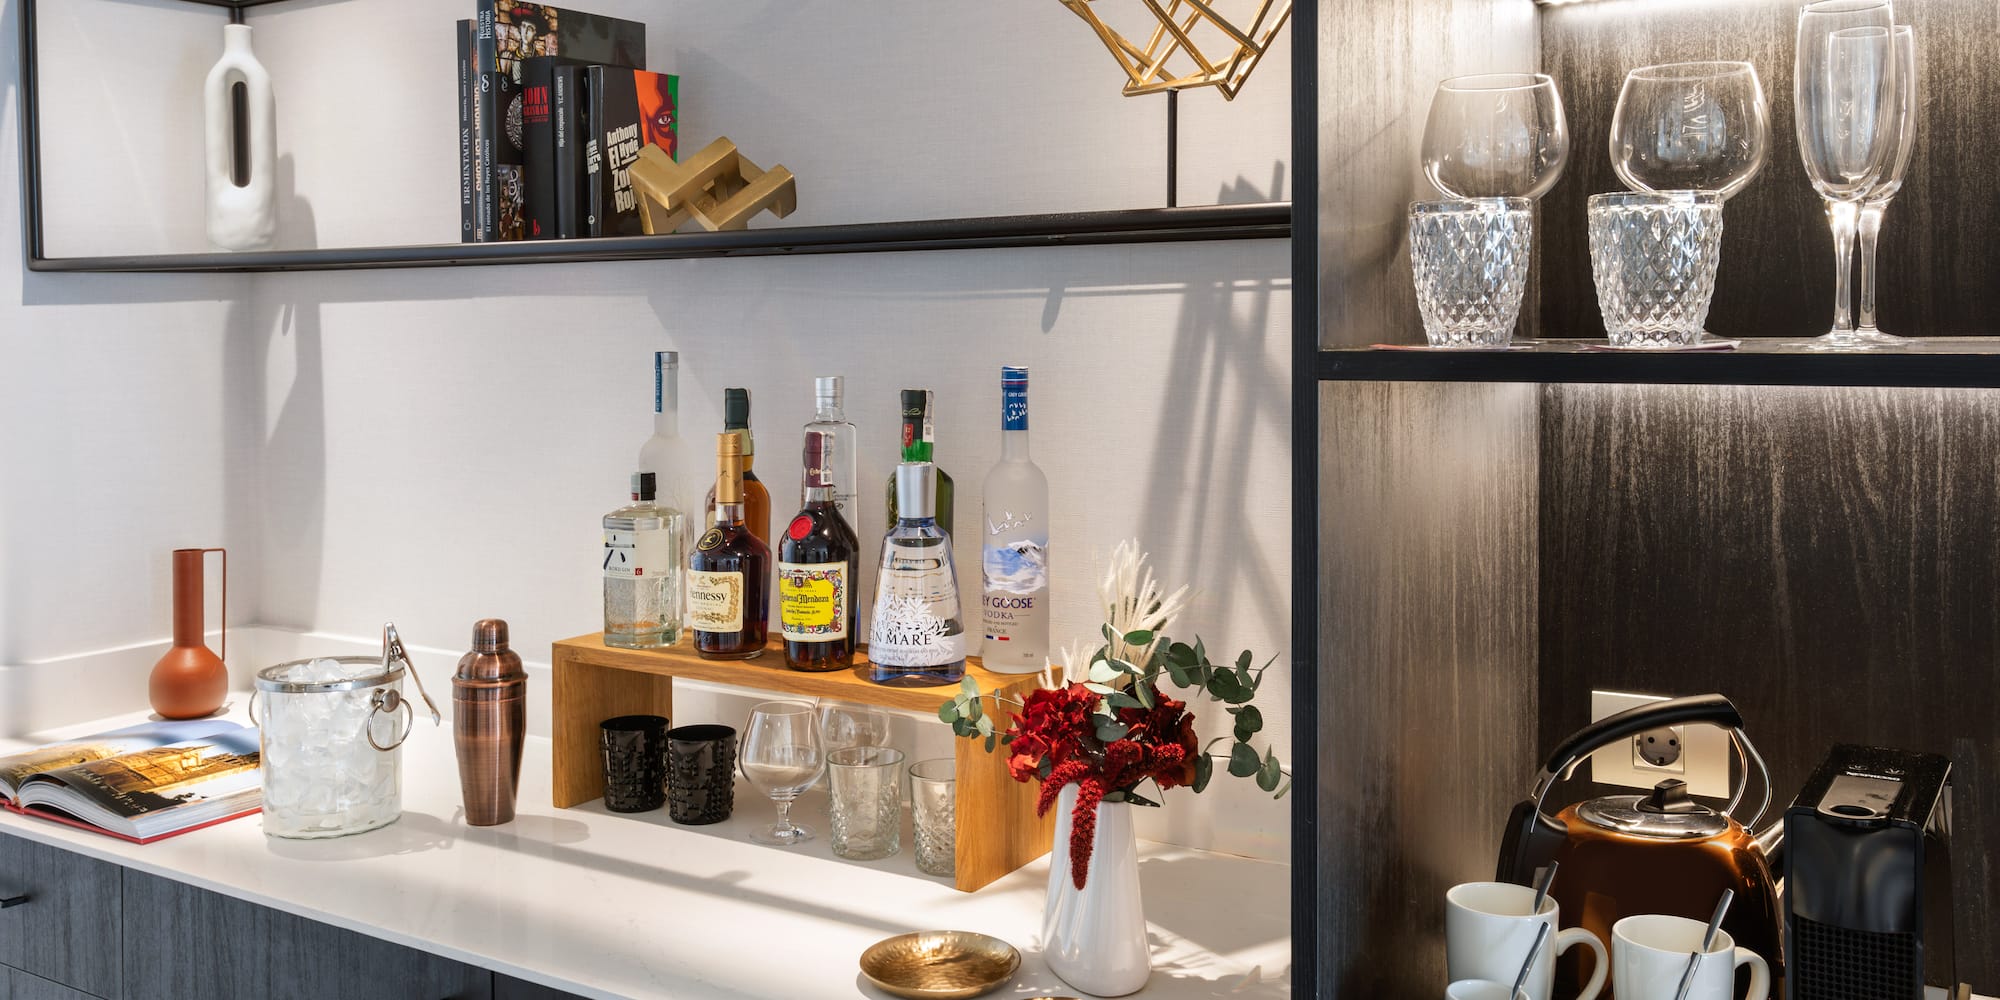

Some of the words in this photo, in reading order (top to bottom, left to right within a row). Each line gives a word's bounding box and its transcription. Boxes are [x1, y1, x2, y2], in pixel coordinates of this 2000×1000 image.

[484, 10, 492, 39] HISTORIA
[523, 86, 548, 105] JOHN
[606, 123, 638, 147] Anthony
[607, 146, 621, 170] El
[619, 139, 639, 159] Hyde
[612, 168, 631, 191] Zor
[485, 194, 491, 202] de
[614, 184, 637, 213] Roj
[992, 598, 1033, 609] GOOSE
[886, 633, 933, 646] MARE
